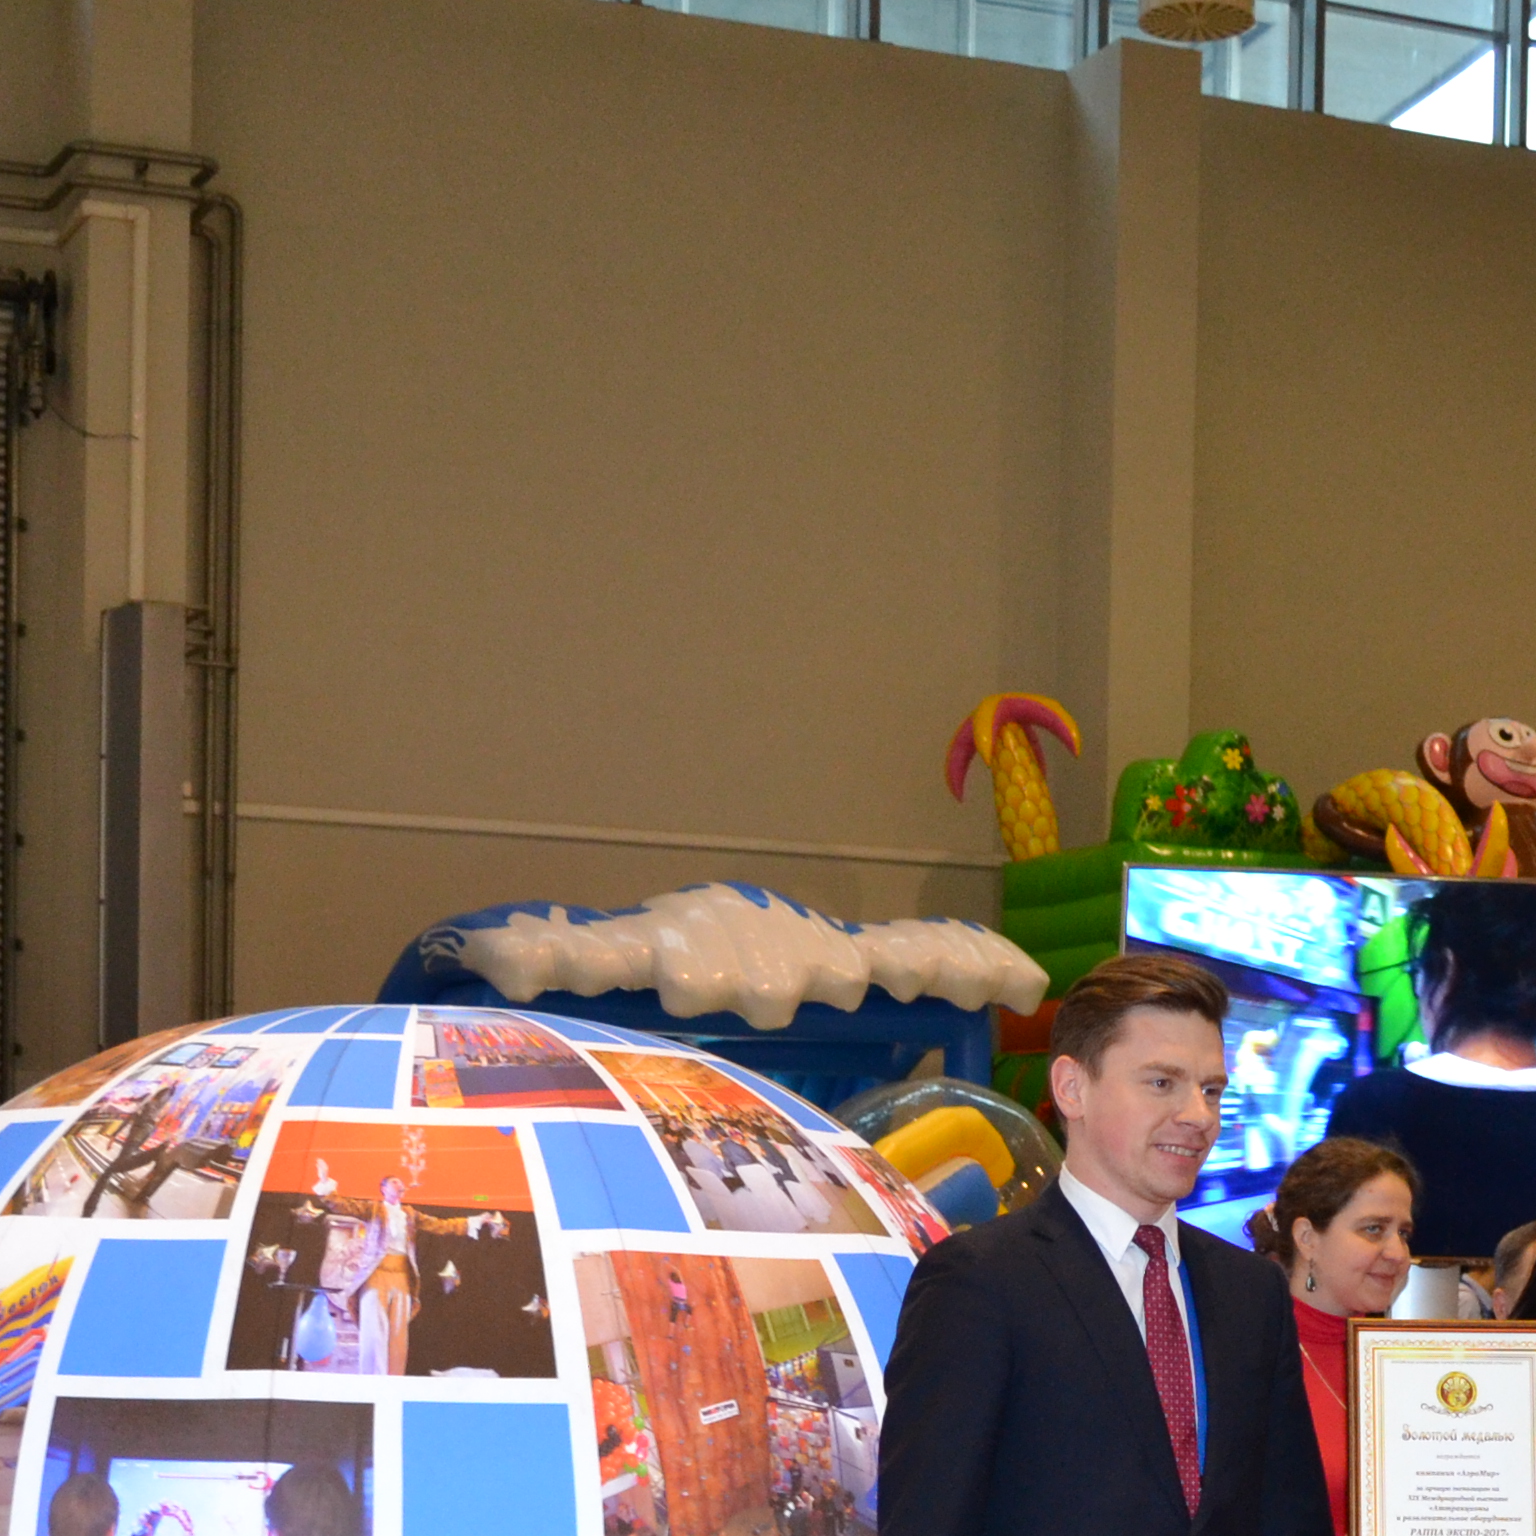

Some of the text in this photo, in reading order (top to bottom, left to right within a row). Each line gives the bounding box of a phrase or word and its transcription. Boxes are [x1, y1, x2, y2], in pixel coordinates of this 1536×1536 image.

[1401, 1424, 1515, 1444] Золотой медалью
[1410, 1529, 1444, 1536] РАППА
